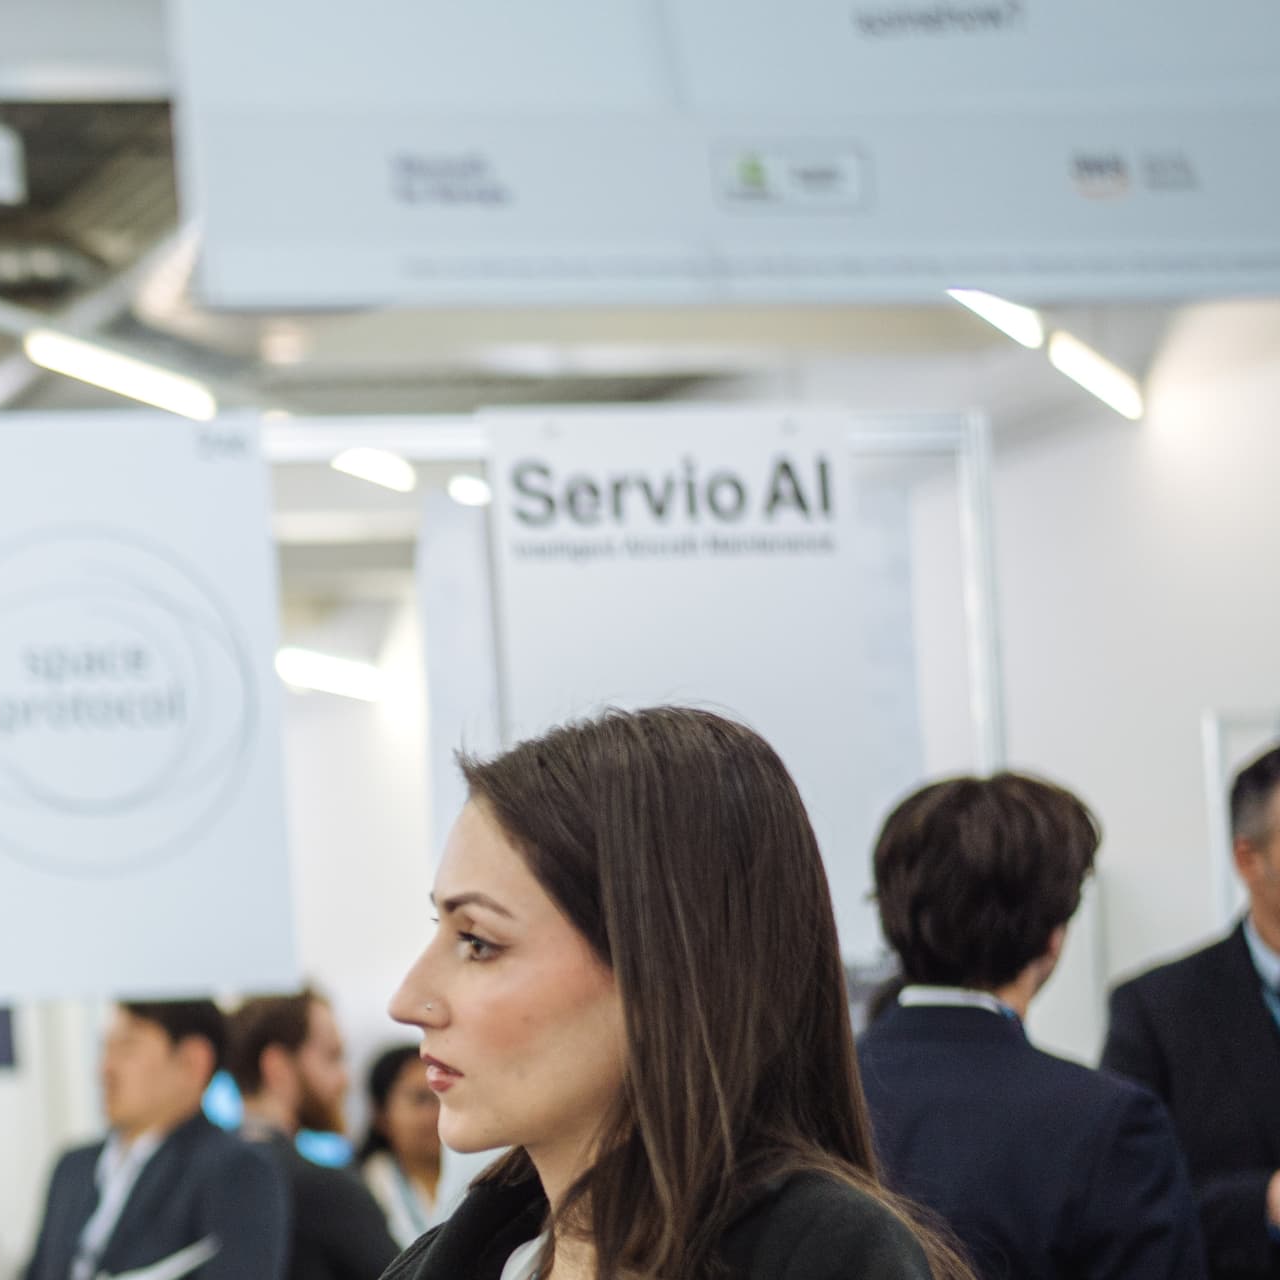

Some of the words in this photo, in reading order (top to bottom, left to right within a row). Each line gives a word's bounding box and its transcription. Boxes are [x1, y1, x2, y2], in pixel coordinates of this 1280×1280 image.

[511, 456, 748, 525] Servio
[766, 455, 834, 520] AI
[22, 644, 148, 681] space
